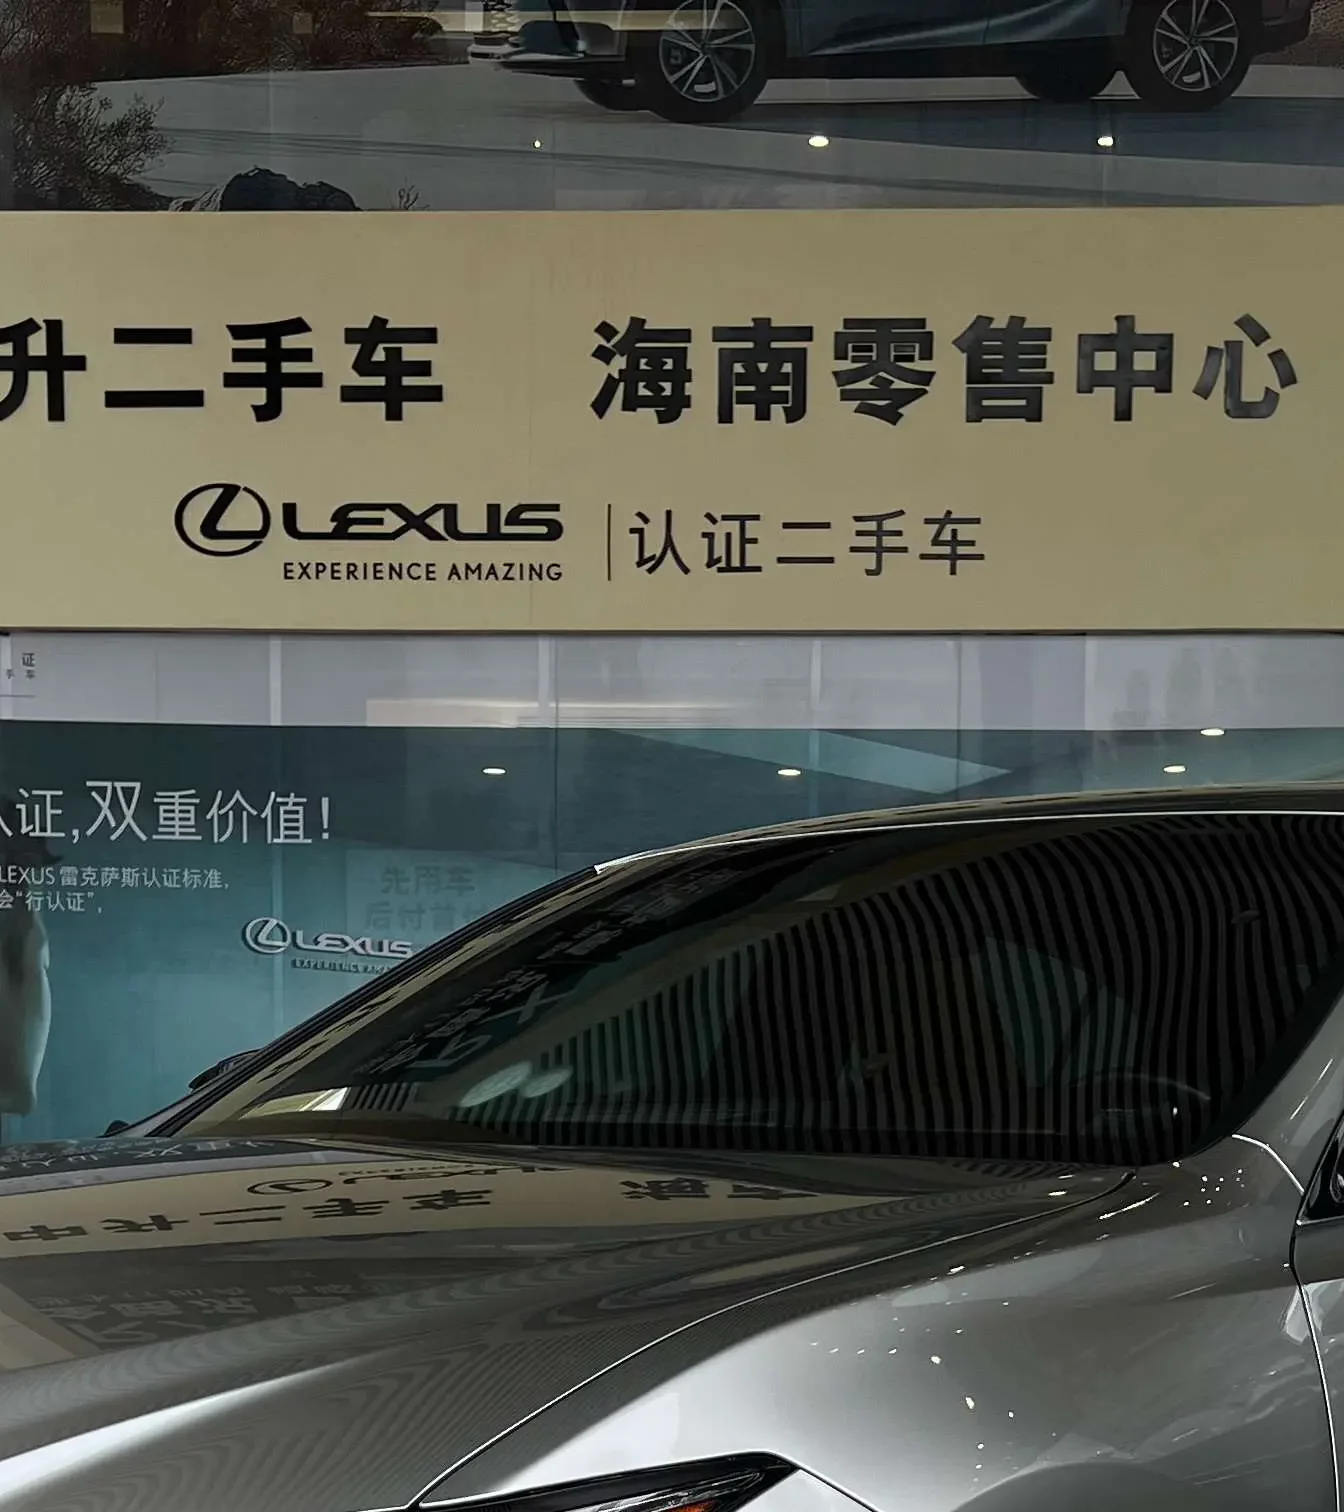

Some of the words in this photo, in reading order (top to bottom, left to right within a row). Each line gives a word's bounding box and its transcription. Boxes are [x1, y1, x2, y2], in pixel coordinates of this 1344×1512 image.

[589, 313, 1299, 427] 海南零售中心
[282, 502, 564, 543] LEXUS
[628, 508, 987, 577] 认证二手车
[283, 561, 438, 582] EXPERIENCE
[447, 561, 564, 582] AMAZING
[296, 929, 413, 959] LEXUS
